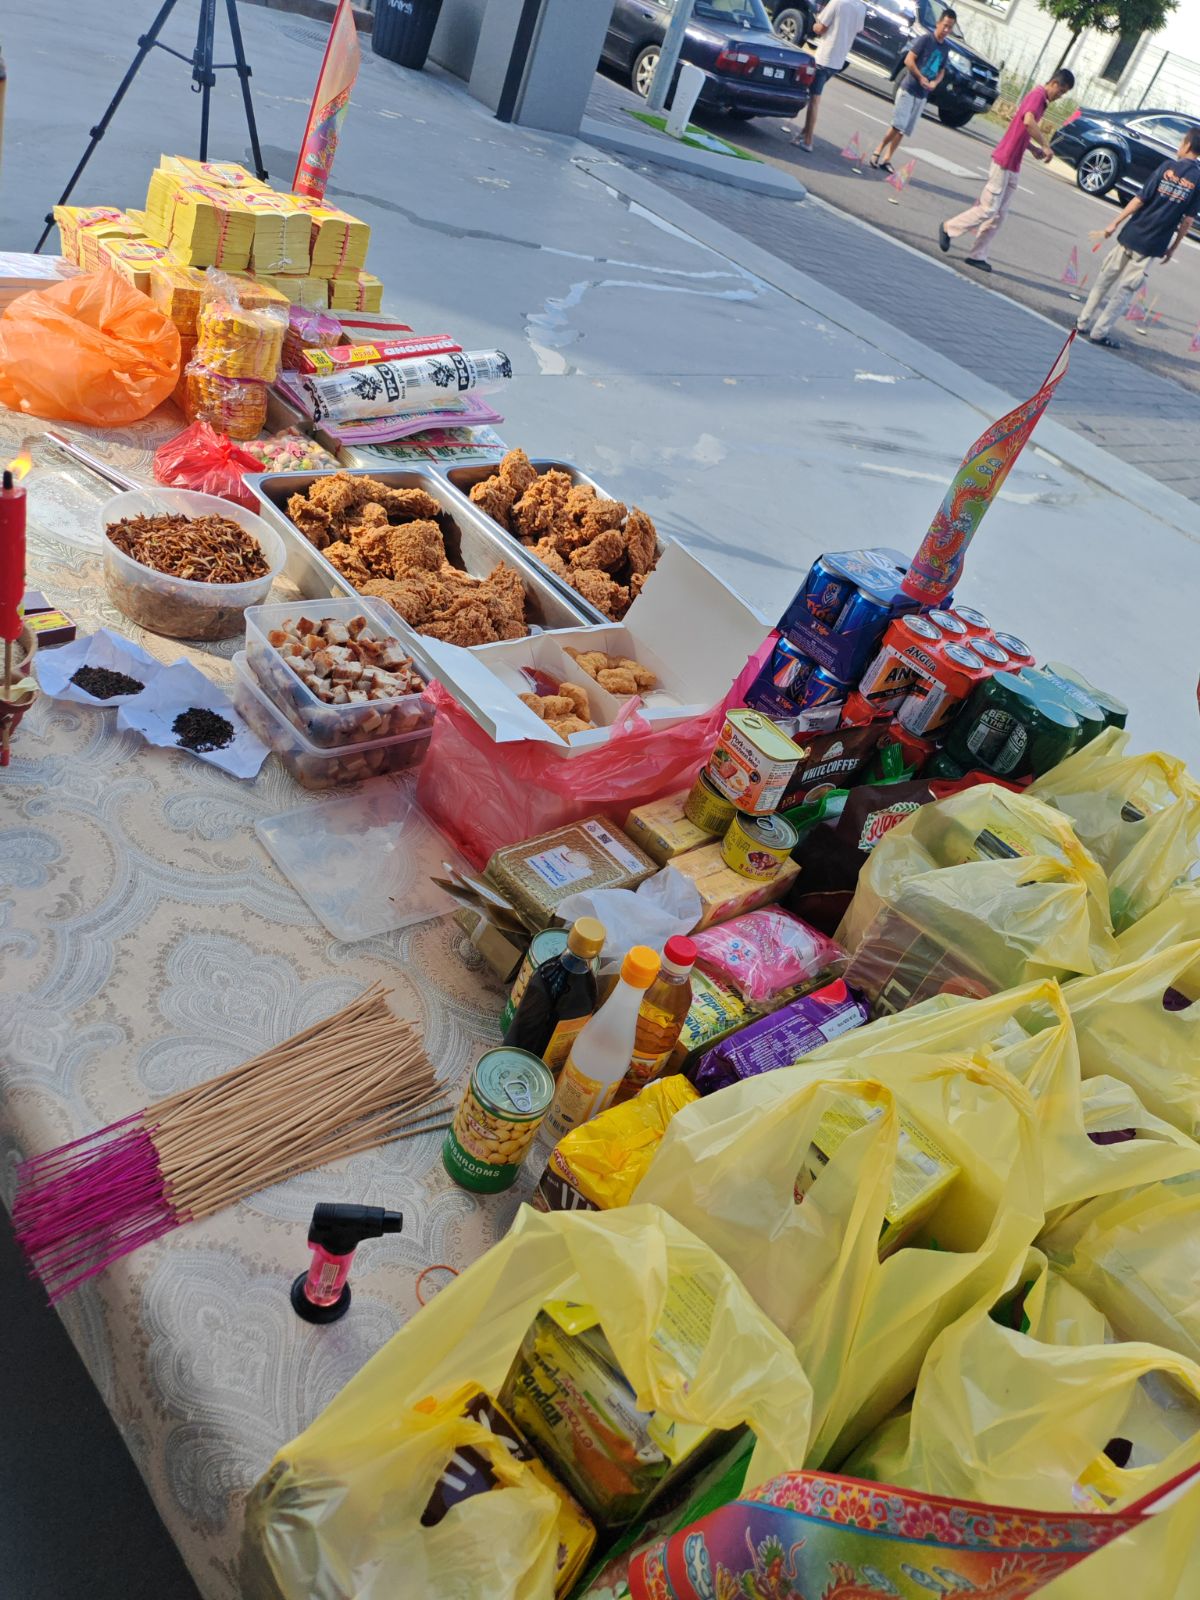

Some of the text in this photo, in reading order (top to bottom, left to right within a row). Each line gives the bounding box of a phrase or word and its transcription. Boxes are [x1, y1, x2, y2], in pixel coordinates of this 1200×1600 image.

[904, 646, 937, 672] ANGLIA
[981, 714, 1003, 729] IN THE
[989, 710, 1012, 724] BEST
[732, 734, 744, 747] Pork
[801, 759, 860, 782] WHITE COFFEE
[448, 1132, 500, 1177] MUSHROOMS
[556, 1400, 594, 1448] APOLLO
